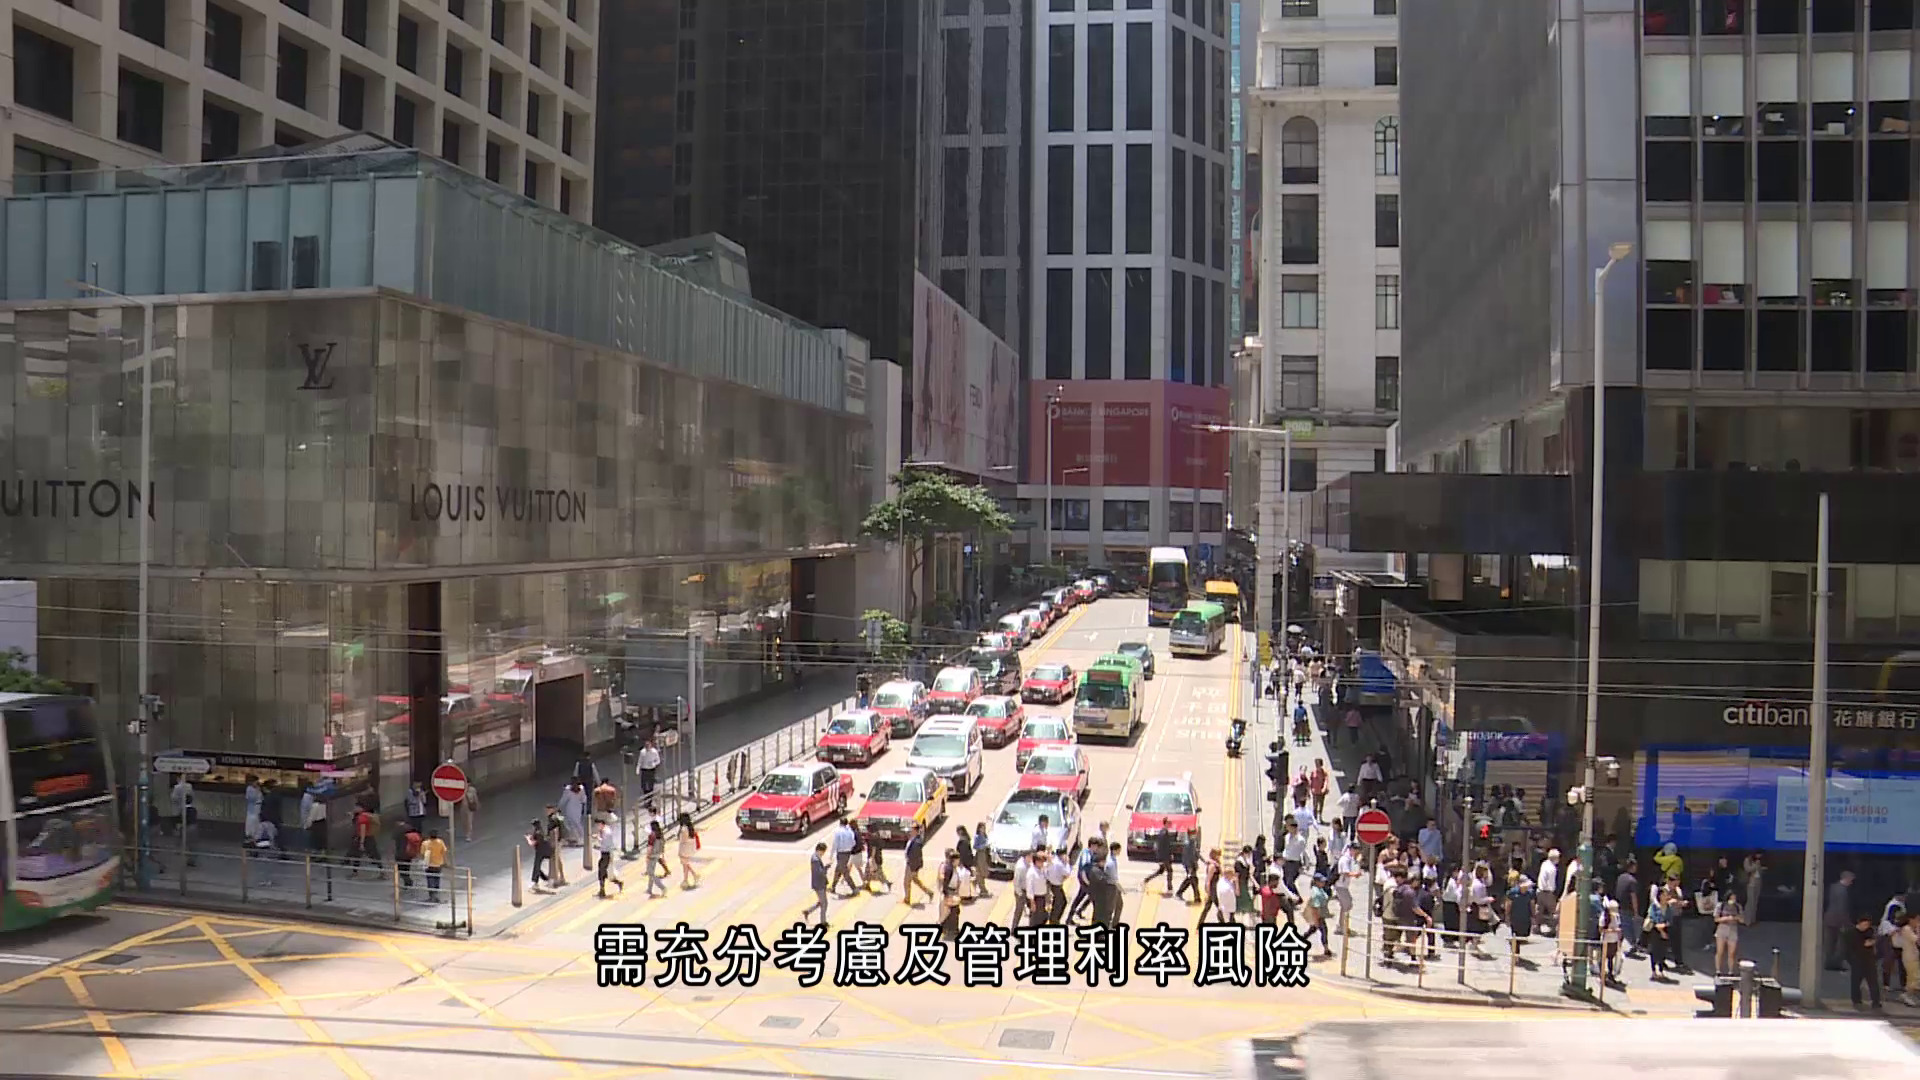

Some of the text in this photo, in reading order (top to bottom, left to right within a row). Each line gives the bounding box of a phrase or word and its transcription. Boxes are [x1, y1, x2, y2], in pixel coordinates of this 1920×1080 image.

[1, 479, 156, 521] UITTON
[410, 483, 586, 524] LOUIS VUITTON
[1723, 703, 1918, 728] citiban 花旗銀行
